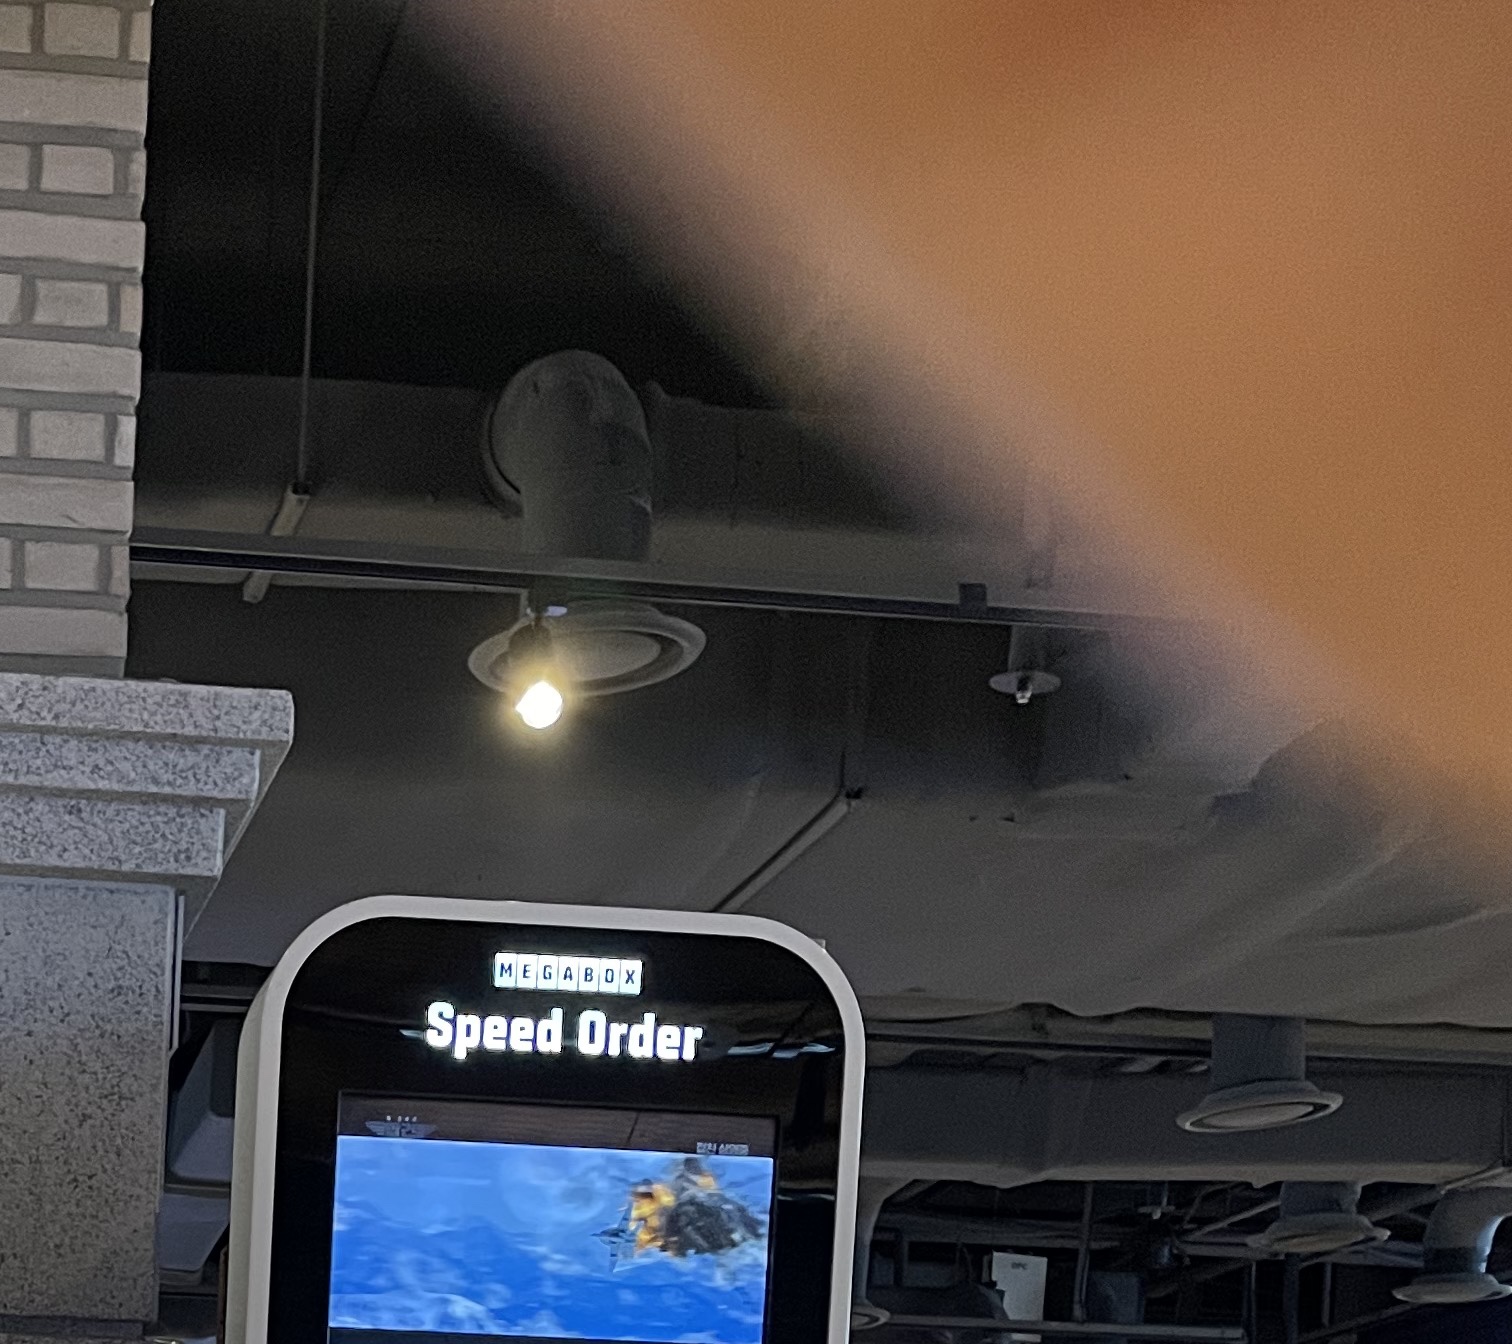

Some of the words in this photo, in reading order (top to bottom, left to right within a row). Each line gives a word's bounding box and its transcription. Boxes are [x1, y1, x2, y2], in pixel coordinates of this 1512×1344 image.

[498, 959, 637, 987] MEGABOX
[426, 1001, 563, 1060] Speed
[578, 1008, 703, 1061] Order
